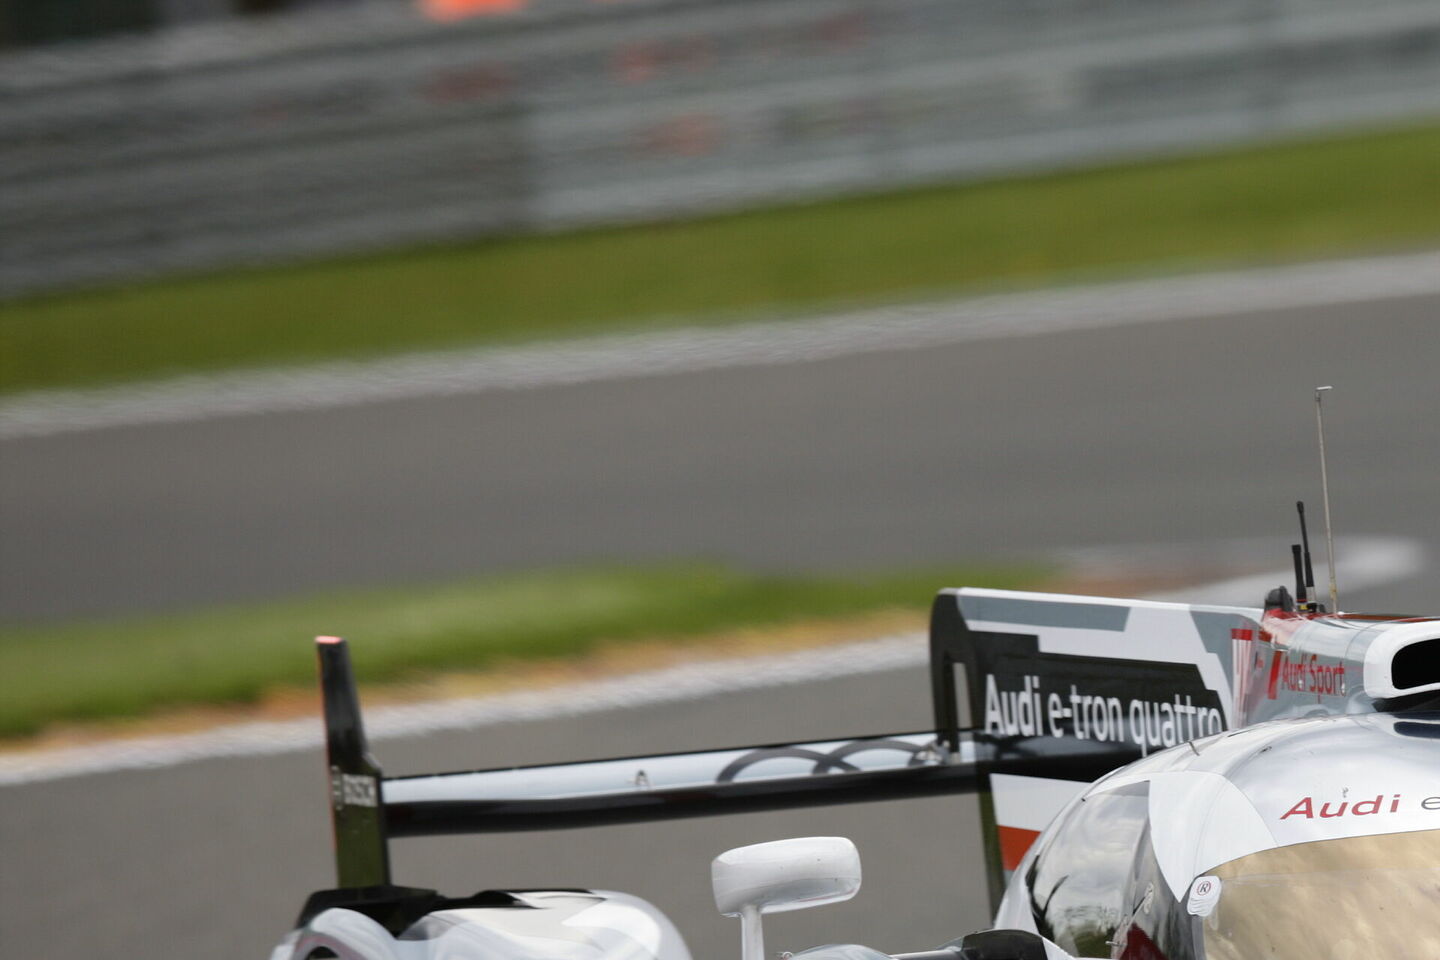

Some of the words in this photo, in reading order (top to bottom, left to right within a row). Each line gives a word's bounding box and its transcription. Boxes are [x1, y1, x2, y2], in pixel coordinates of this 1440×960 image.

[1309, 654, 1346, 704] Sport
[984, 674, 1044, 737] Audi
[1048, 684, 1125, 743] e-tron
[1129, 693, 1223, 757] quattro
[1280, 794, 1401, 820] Audi
